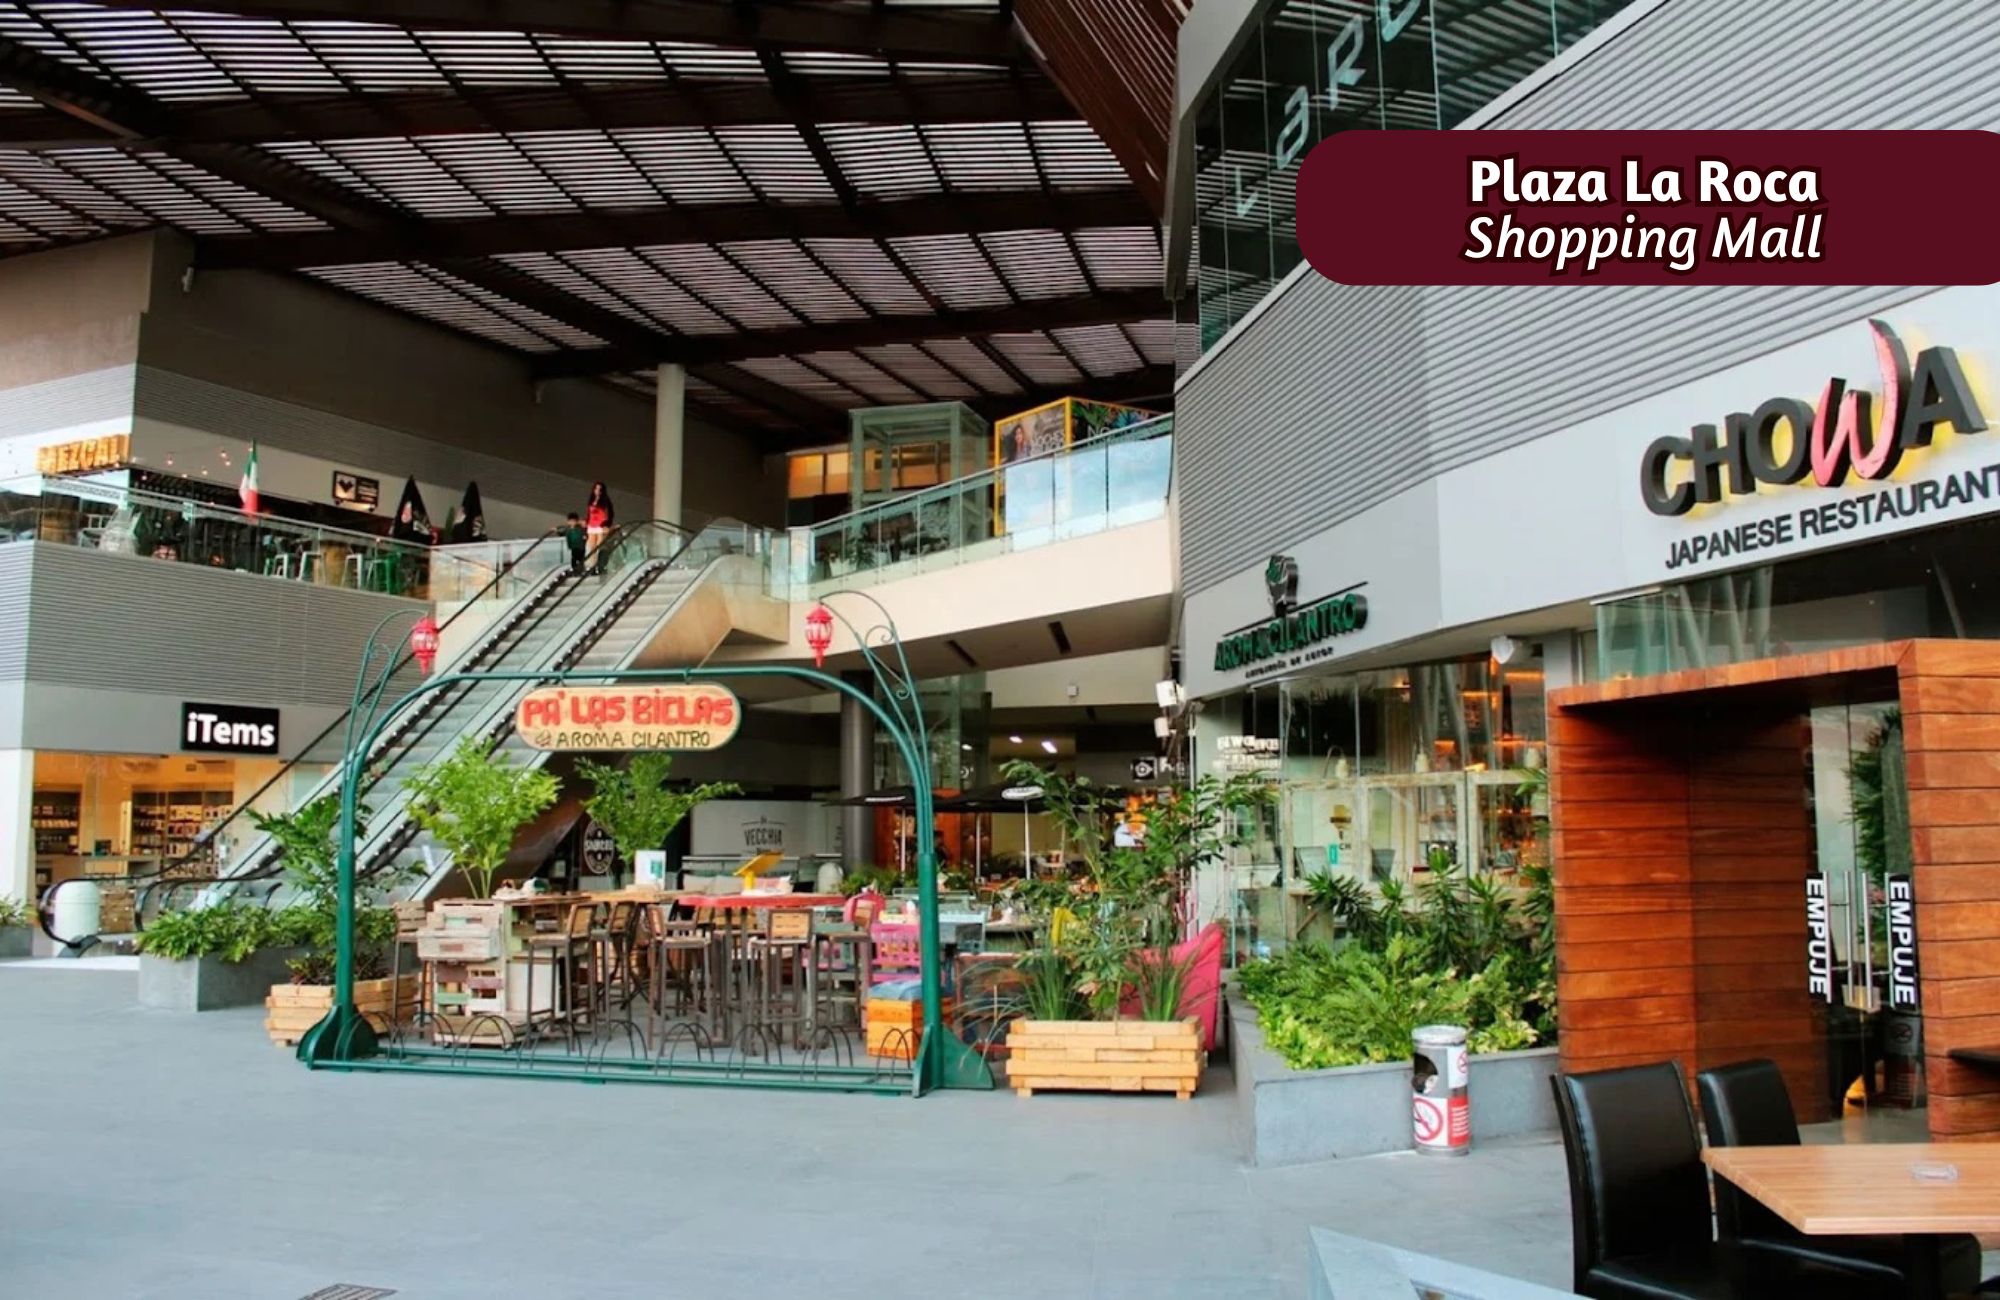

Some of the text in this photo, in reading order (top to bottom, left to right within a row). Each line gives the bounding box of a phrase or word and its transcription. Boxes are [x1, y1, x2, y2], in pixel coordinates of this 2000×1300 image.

[1640, 318, 1989, 516] CHOWA
[1665, 514, 1793, 569] JAPANESE
[187, 712, 275, 747] iTems
[571, 696, 626, 725] LAS
[556, 730, 710, 748] AROMA CILANTRO
[1806, 878, 1828, 994] EMPUJE
[1889, 881, 1915, 1004] EMPUJE
